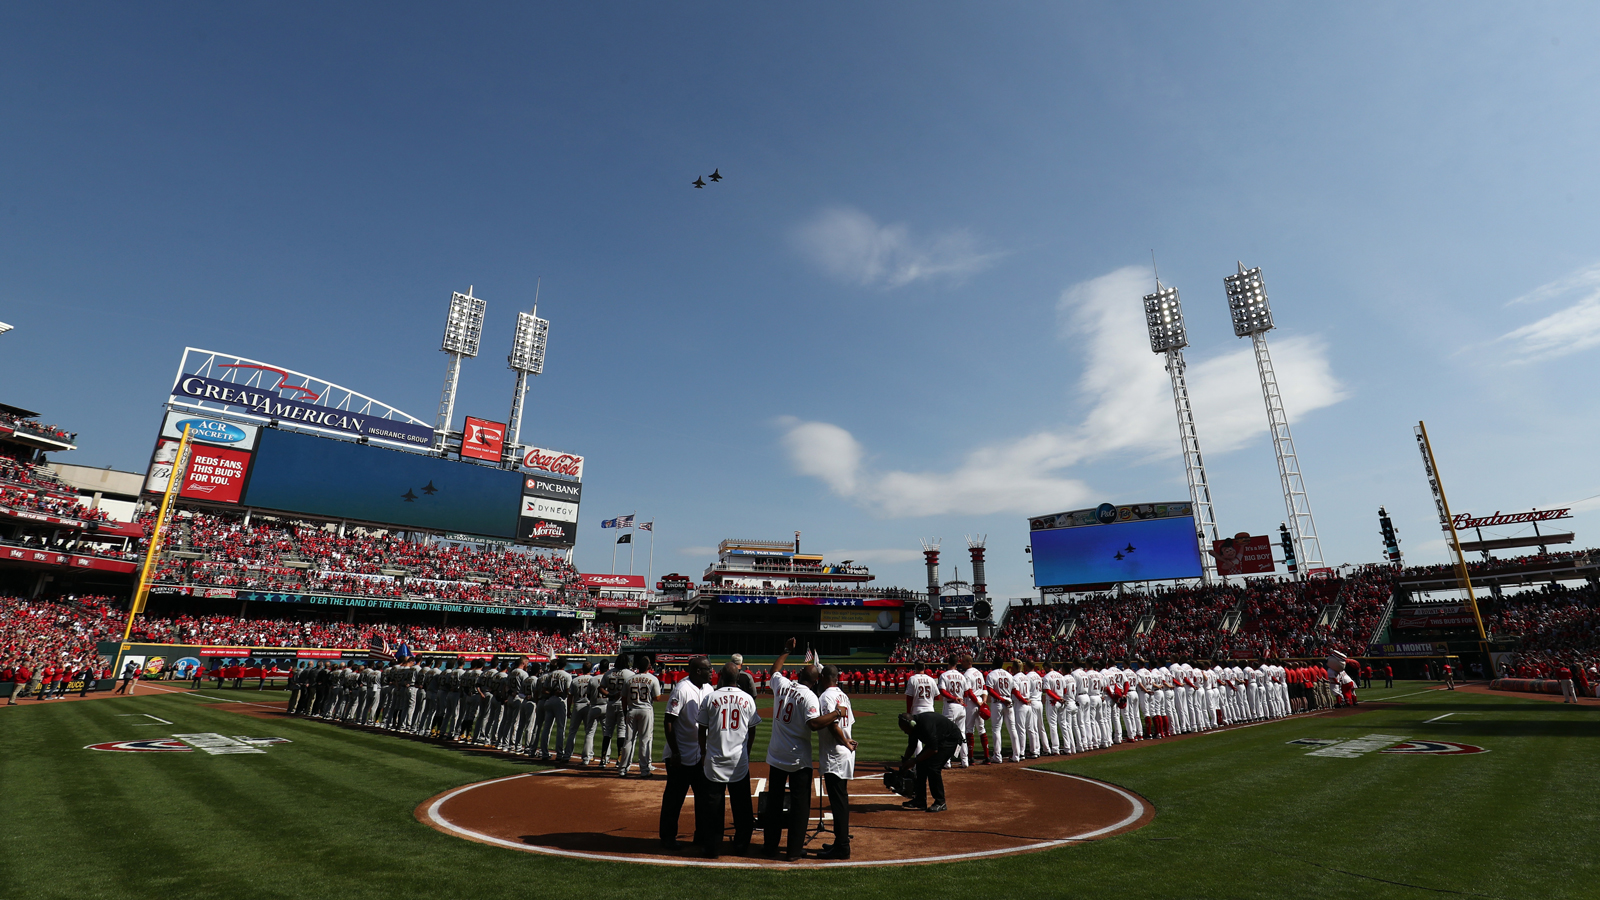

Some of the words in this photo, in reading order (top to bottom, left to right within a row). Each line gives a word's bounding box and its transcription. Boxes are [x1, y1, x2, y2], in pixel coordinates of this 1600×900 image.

[182, 377, 264, 407] GREAT
[198, 420, 227, 432] ACR
[190, 428, 235, 441] ONCRETE
[368, 427, 406, 440] INSURANCE
[406, 434, 429, 444] GROUP
[194, 455, 219, 466] REDS
[219, 459, 244, 471] FANS,
[193, 464, 214, 474] THIS
[214, 467, 242, 478] BUD'S
[189, 473, 209, 483] FOR
[210, 476, 230, 486] YOU.
[538, 504, 573, 516] DYNEGY
[1100, 510, 1115, 518] P&G
[544, 521, 558, 529] John
[1452, 508, 1569, 531] Budweiser
[446, 534, 475, 543] ULTIMATE
[486, 539, 512, 547] SHUTTLE
[1244, 554, 1256, 562] BIG
[588, 575, 630, 584] Reds
[309, 596, 328, 604] O'ER
[329, 598, 344, 606] THE
[345, 599, 367, 607] LAND
[367, 600, 378, 608] OF
[379, 600, 393, 609] THE
[393, 601, 411, 609] FREE
[411, 602, 428, 610] AND
[428, 603, 442, 611] THE
[442, 604, 462, 612] HOME
[463, 605, 472, 613] OF
[473, 606, 485, 614] THE
[486, 607, 507, 615] BRAVE
[1443, 617, 1461, 625] BUD'S
[1473, 616, 1488, 624] YU.
[1383, 644, 1395, 653] $10
[1396, 644, 1402, 652] A
[1402, 643, 1433, 652] MONTH
[147, 659, 165, 669] Kahn's
[608, 678, 625, 691] 55
[628, 675, 652, 685] CABRERA
[998, 677, 1009, 690] 66
[630, 686, 649, 701] 53
[918, 685, 931, 699] 25
[949, 680, 961, 694] 33
[711, 694, 749, 709] MISTICS
[776, 699, 794, 724] 19
[720, 708, 740, 731] 19
